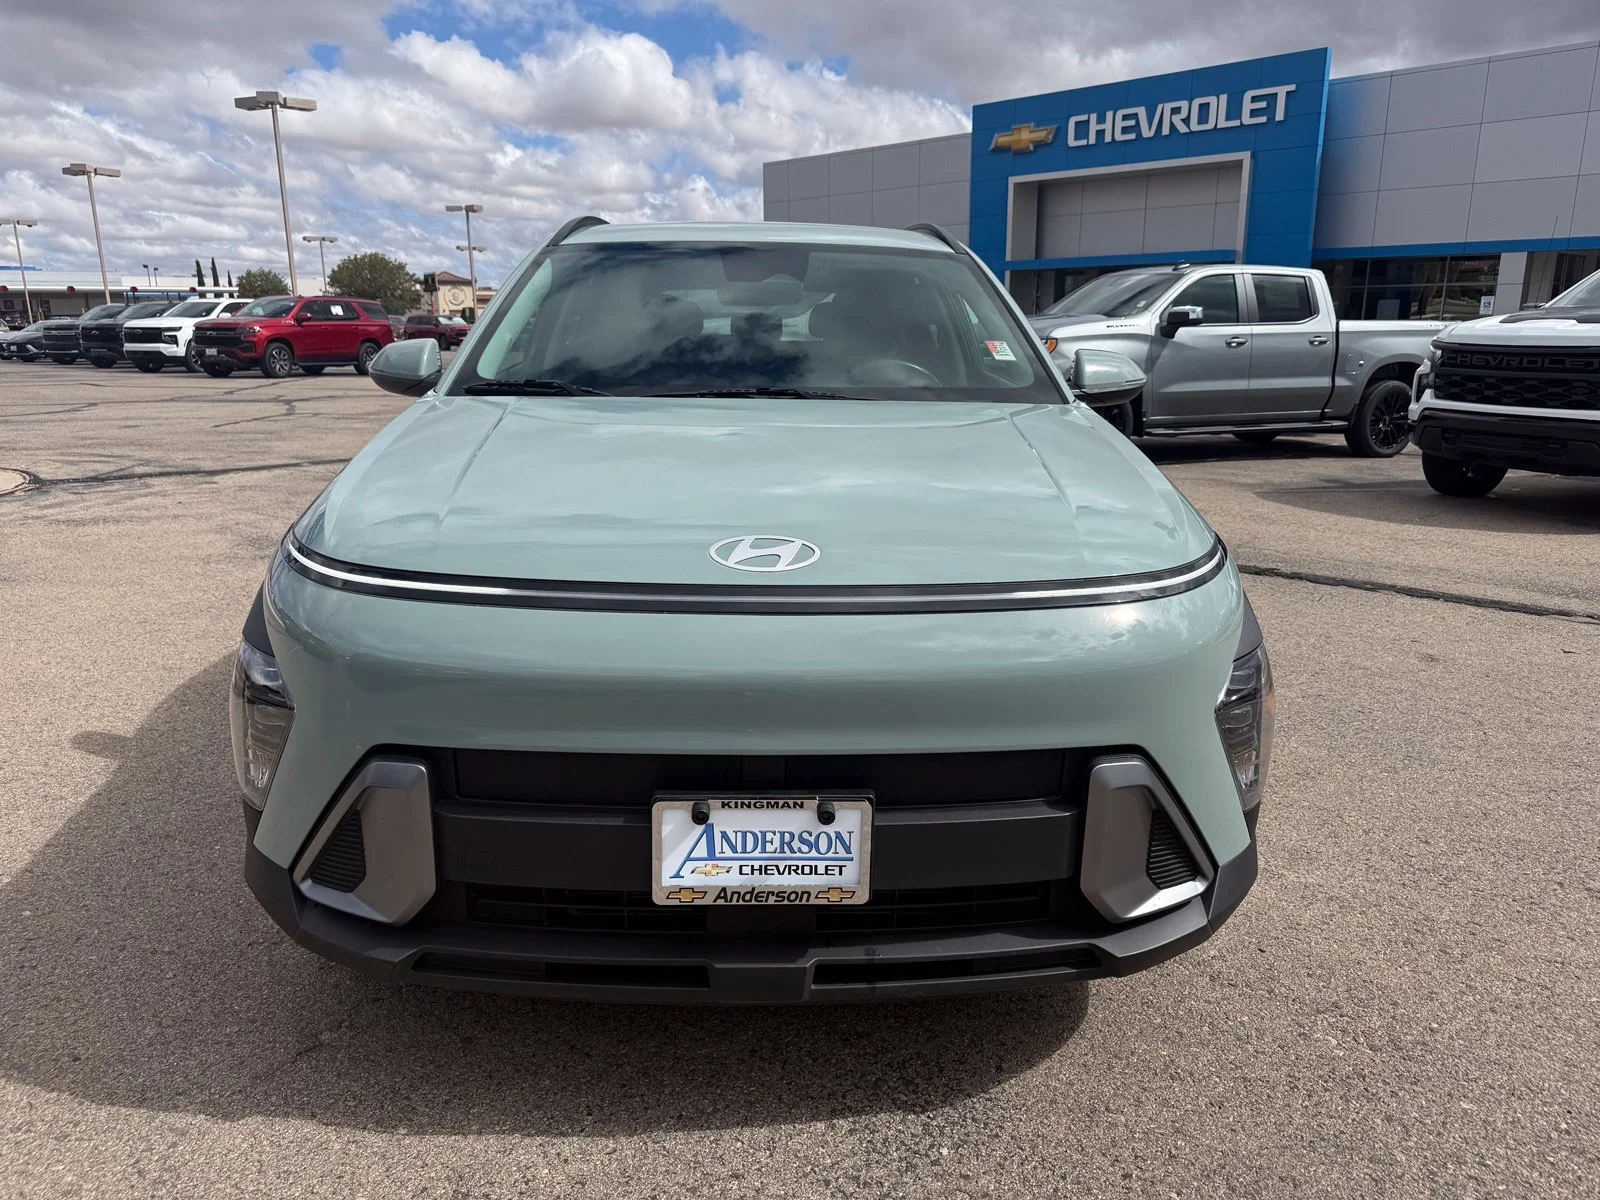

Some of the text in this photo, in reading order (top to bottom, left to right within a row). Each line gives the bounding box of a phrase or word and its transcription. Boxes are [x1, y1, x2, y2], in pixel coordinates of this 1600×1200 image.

[1068, 84, 1296, 147] CHEVROLET
[721, 801, 804, 809] KINGMAN
[669, 823, 854, 878] ANDERSON
[738, 864, 847, 876] CHEVROLET
[713, 887, 811, 903] Anderson
